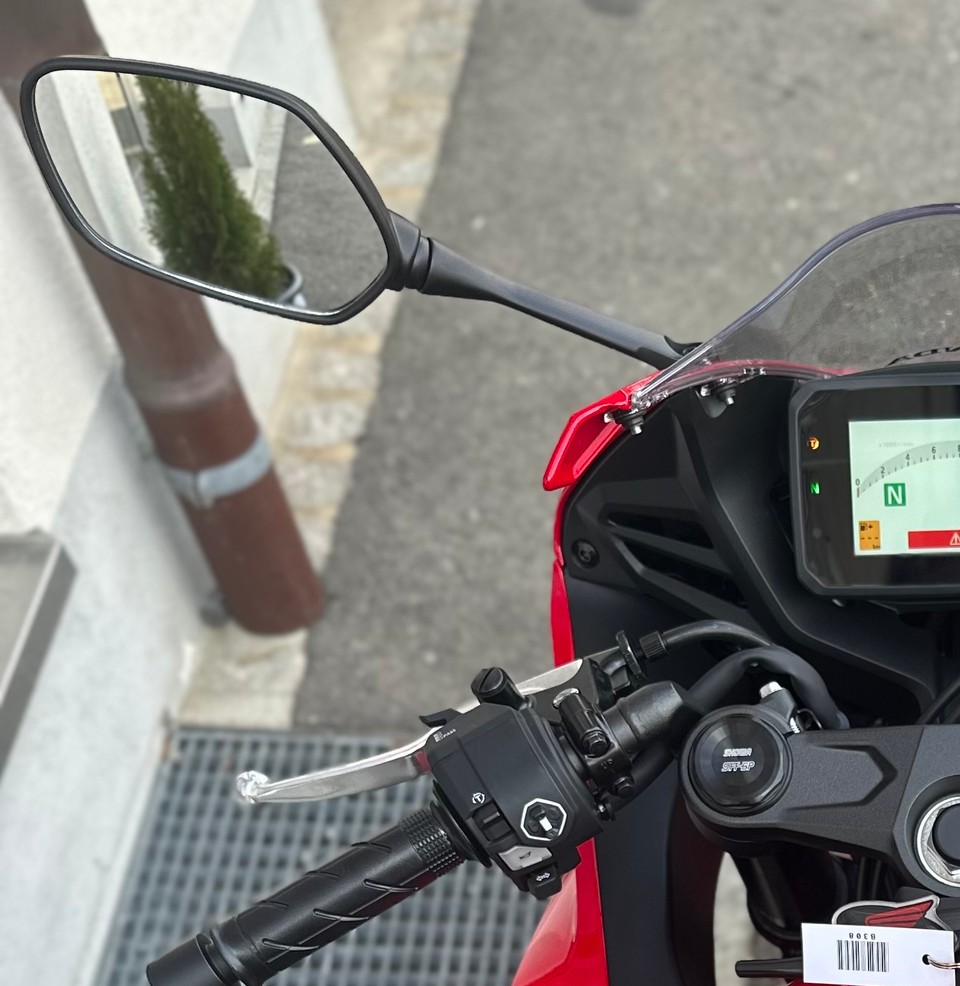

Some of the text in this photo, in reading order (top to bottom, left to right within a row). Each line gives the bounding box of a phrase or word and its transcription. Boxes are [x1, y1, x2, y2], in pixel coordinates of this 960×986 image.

[931, 446, 936, 454] 6
[880, 466, 885, 474] 2
[887, 485, 903, 505] N
